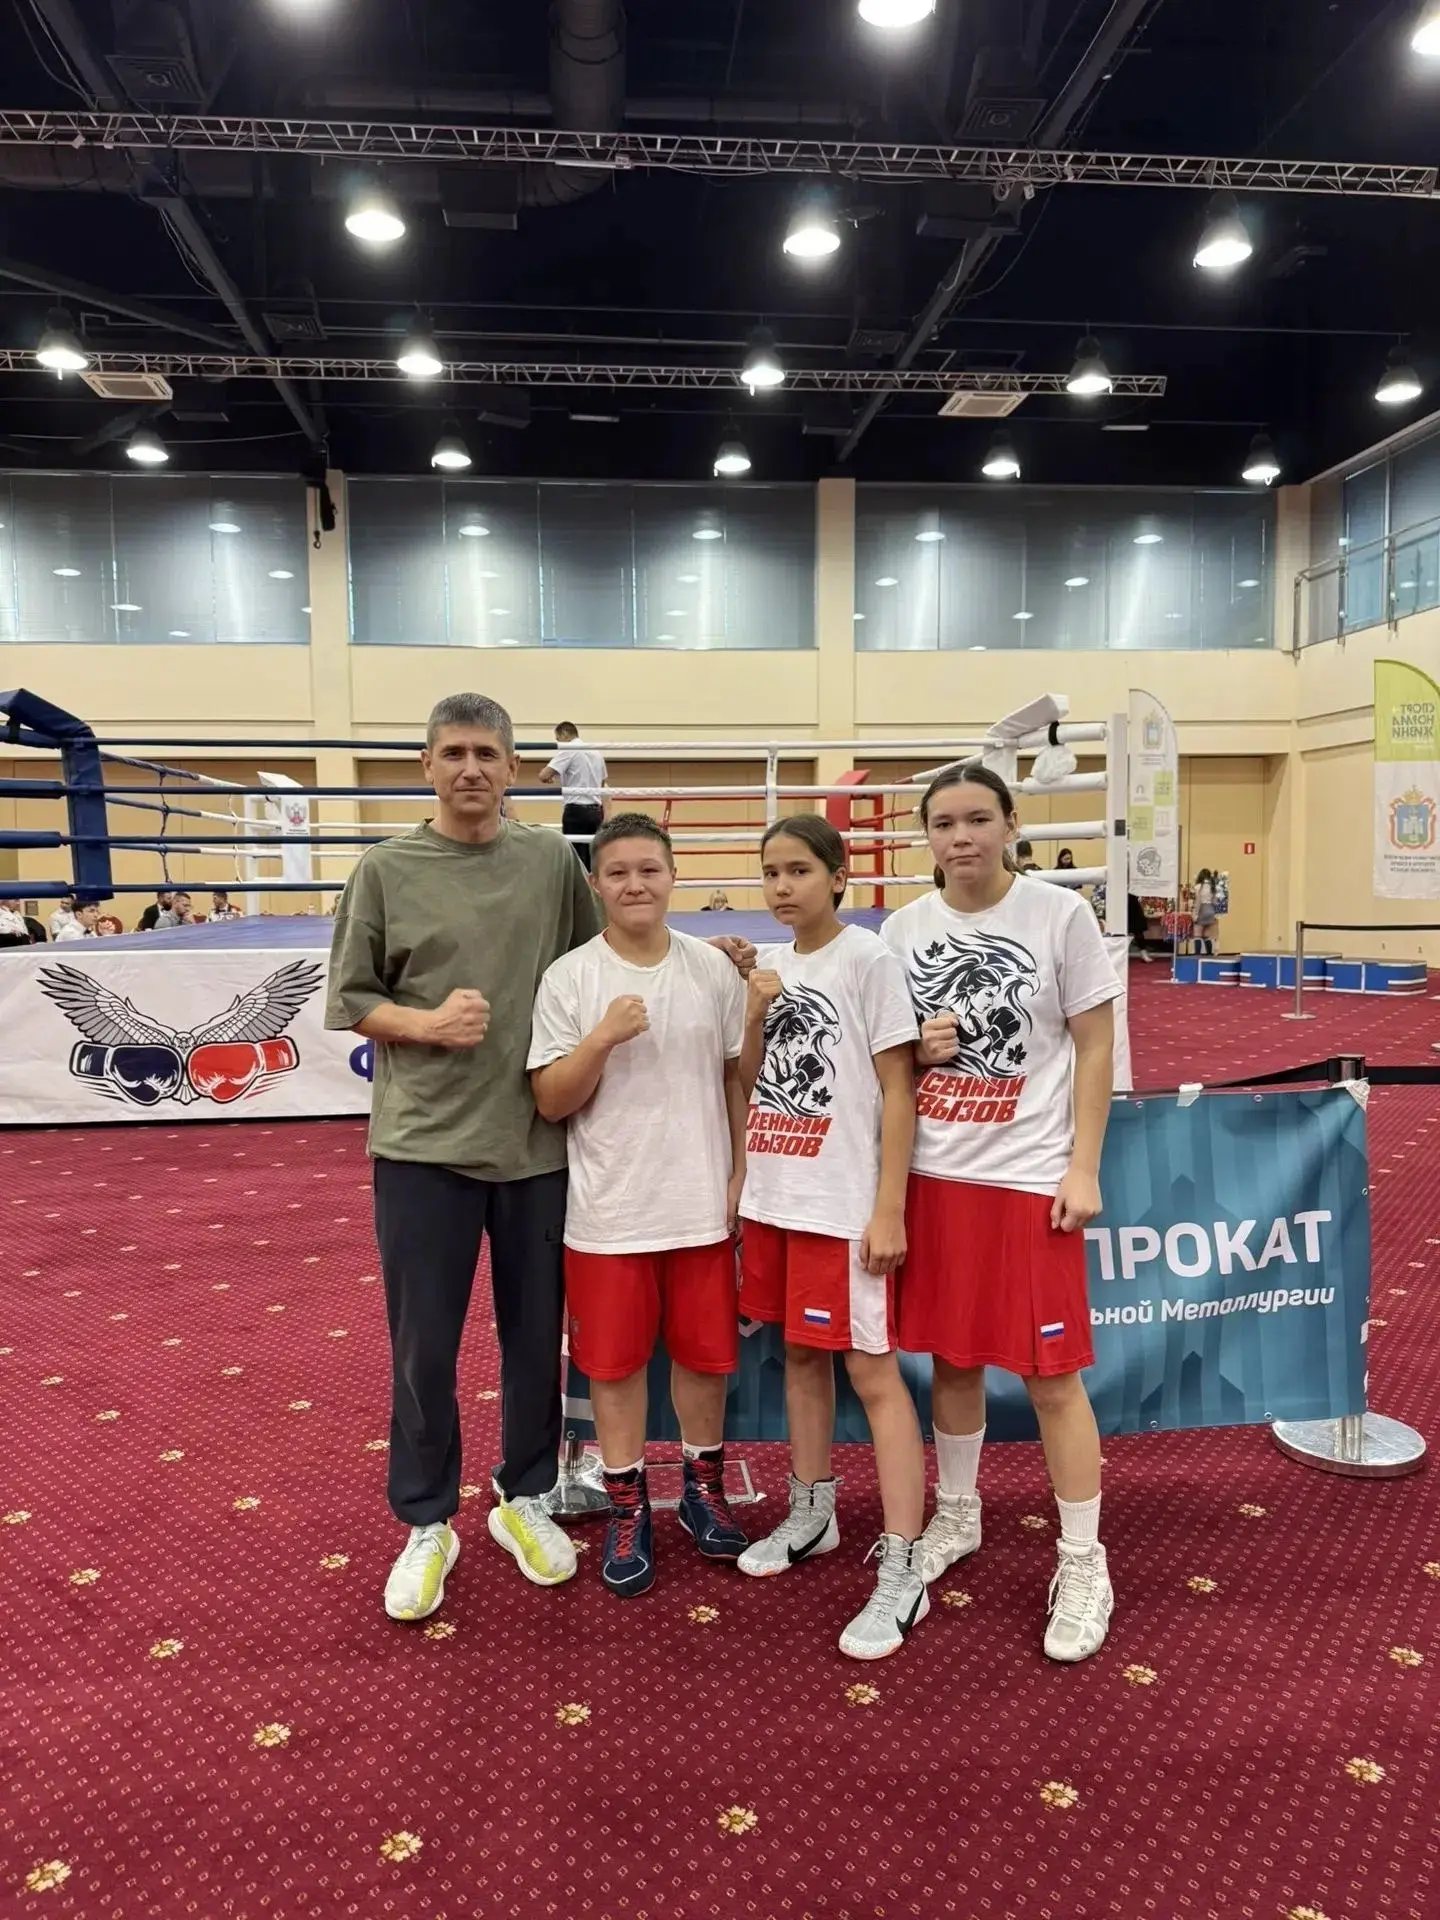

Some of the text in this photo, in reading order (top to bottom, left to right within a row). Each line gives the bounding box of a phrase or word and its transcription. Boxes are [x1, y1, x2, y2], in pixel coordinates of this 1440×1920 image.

[916, 1092, 1018, 1123] ВЫЗОВ
[747, 1132, 823, 1157] ВЫЗОВ
[1161, 1287, 1335, 1322] Металлургии
